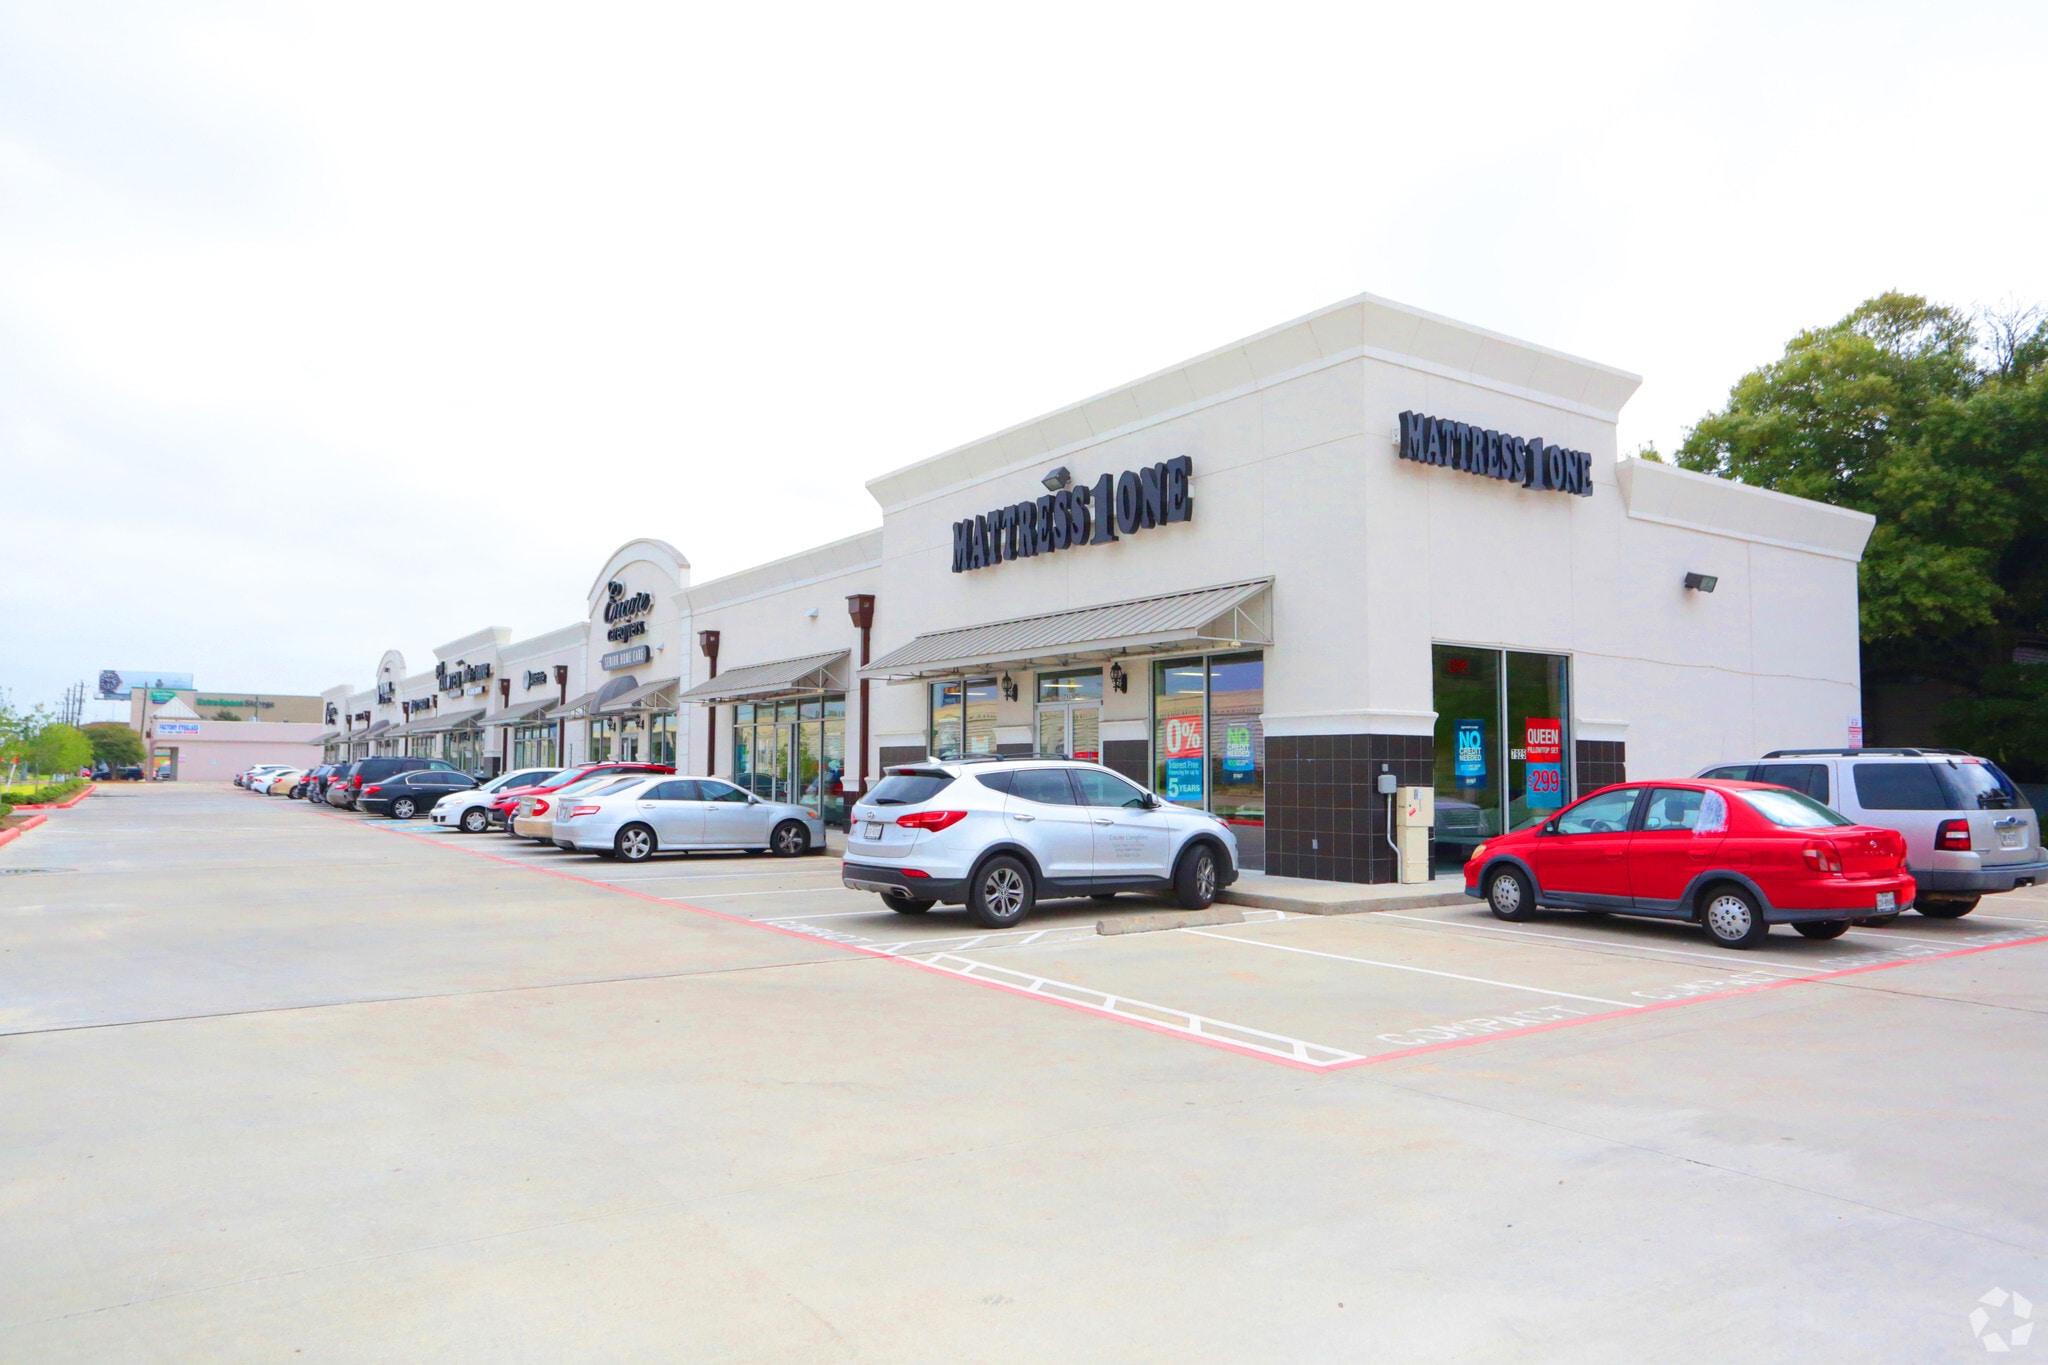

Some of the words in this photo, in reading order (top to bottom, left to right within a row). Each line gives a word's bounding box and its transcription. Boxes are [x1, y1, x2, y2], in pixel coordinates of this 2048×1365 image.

[604, 654, 619, 668] SENIOR
[620, 652, 632, 665] HOME
[633, 648, 644, 662] CARE
[1167, 719, 1201, 754] 0%
[1227, 727, 1250, 745] NO
[1459, 730, 1481, 749] NO
[1527, 728, 1559, 745] QUEEN
[1459, 747, 1482, 756] CREDIT
[1168, 761, 1187, 769] Interest
[1187, 761, 1199, 769] Free
[1168, 777, 1179, 798] 5
[1179, 784, 1201, 793] YEARS
[1528, 769, 1560, 793] $299
[1376, 1004, 1588, 1046] COMPACT
